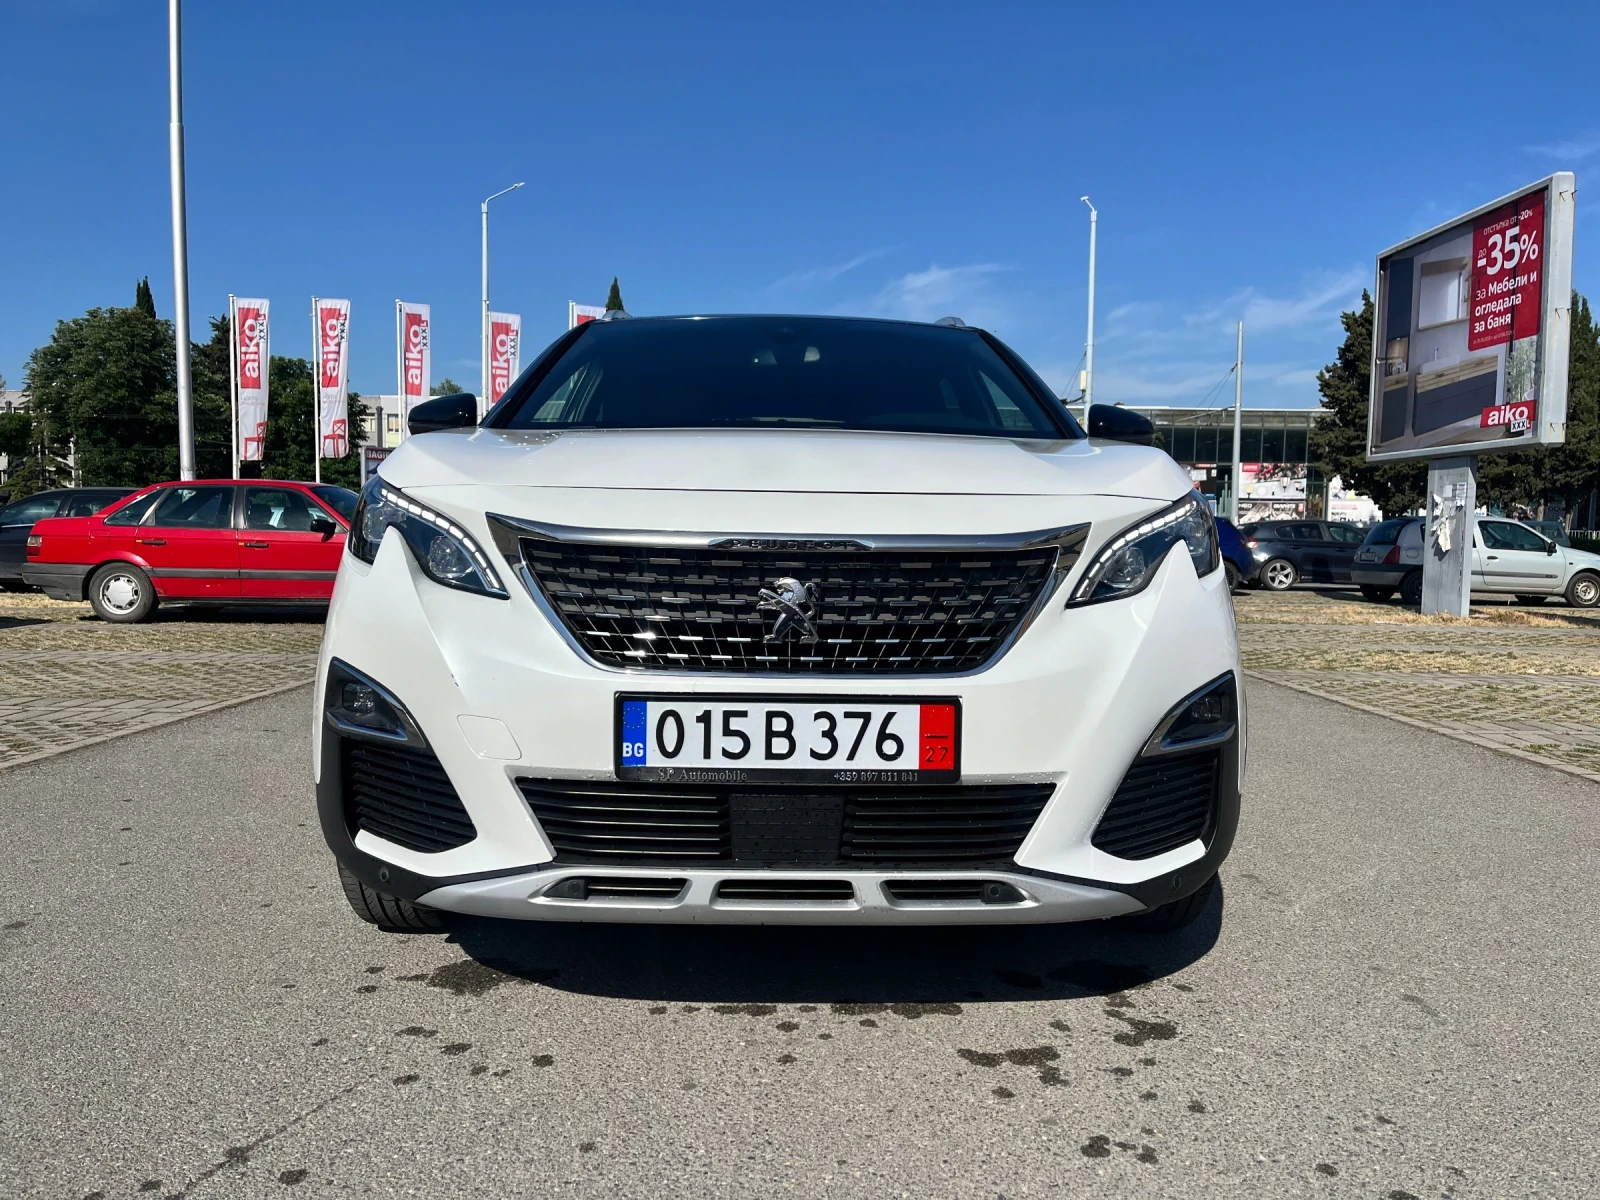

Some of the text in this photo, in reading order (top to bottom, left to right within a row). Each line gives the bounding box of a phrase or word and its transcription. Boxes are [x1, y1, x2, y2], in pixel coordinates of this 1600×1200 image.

[1477, 225, 1539, 276] -35%
[1475, 270, 1537, 301] за Мебели и
[1475, 293, 1522, 317] огледала
[1473, 313, 1512, 334] за баня
[241, 318, 259, 378] aiko
[323, 318, 339, 377] aiko
[406, 324, 422, 386] aiko
[492, 333, 509, 394] aiko
[1487, 404, 1529, 426] aiko
[728, 539, 853, 550] PEUGEOT
[622, 742, 644, 758] BG
[925, 747, 949, 763] 27
[679, 768, 748, 781] Automobile
